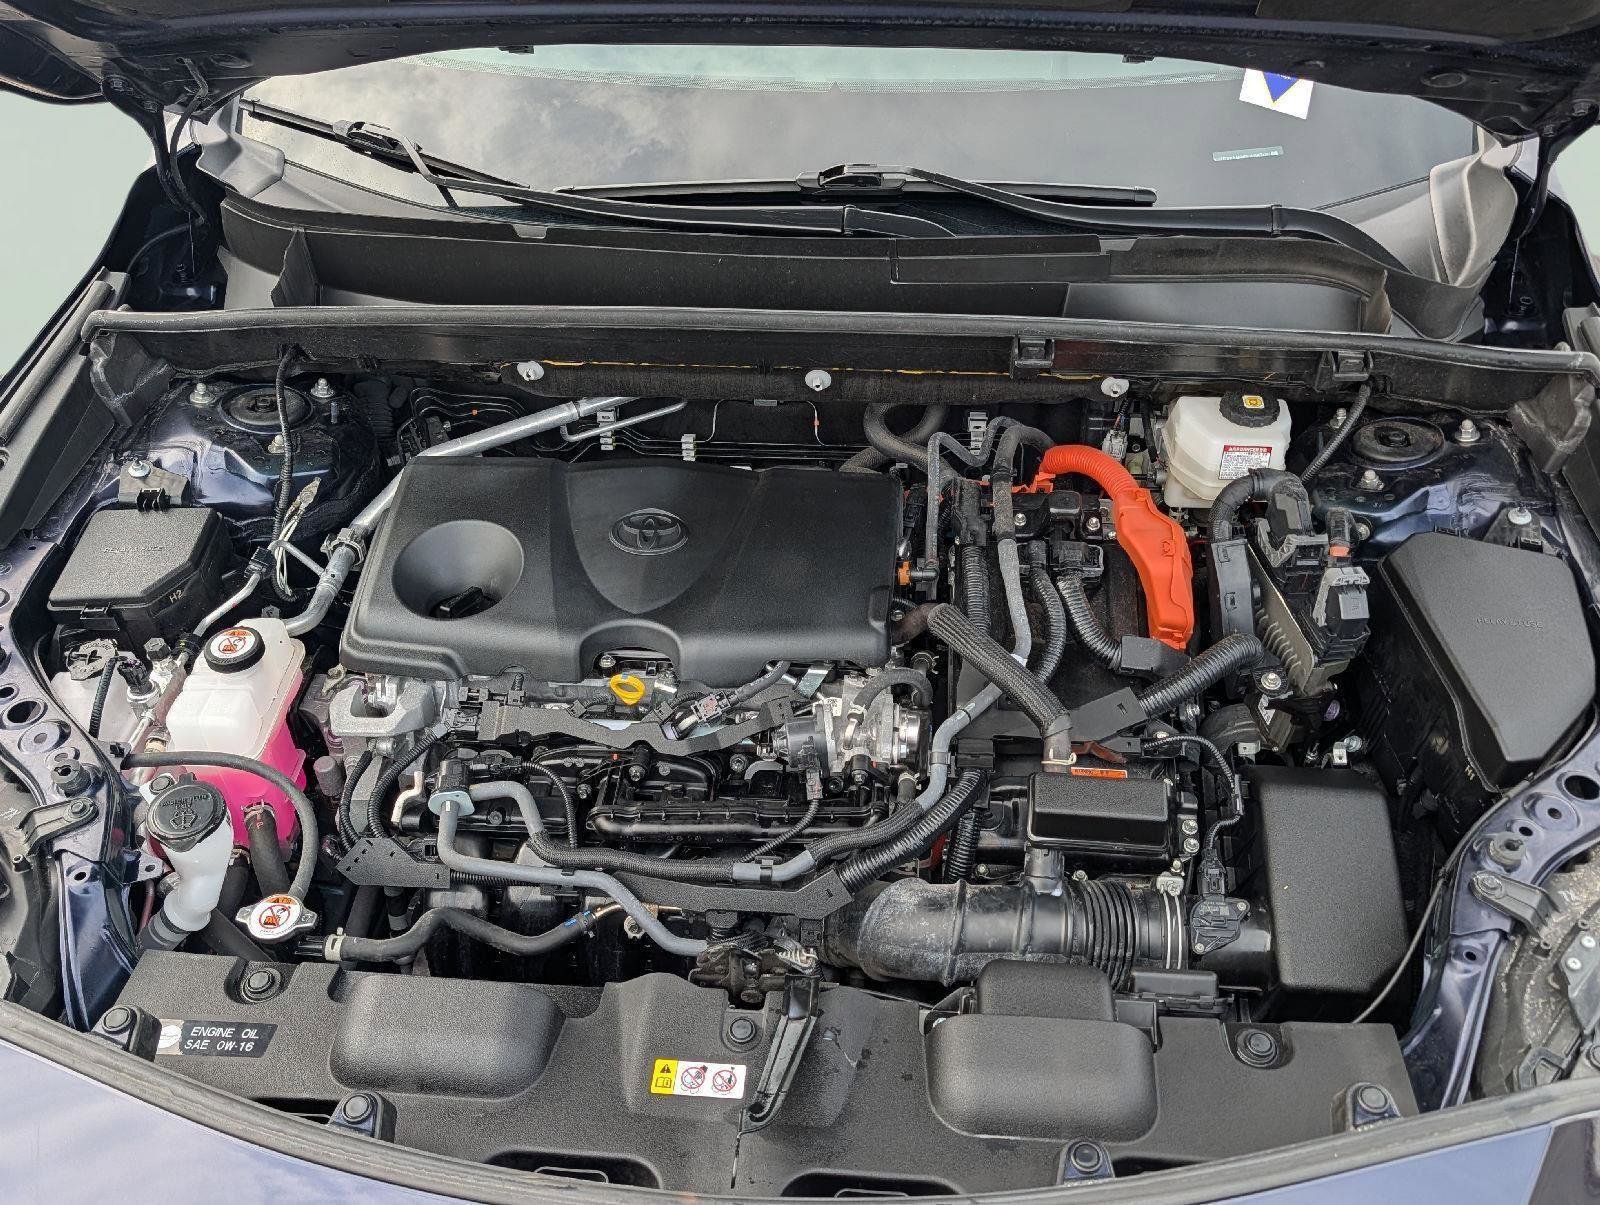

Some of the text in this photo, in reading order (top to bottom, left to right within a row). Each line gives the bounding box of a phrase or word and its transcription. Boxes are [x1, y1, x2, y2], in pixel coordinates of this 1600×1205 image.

[169, 589, 183, 604] H2
[190, 1026, 260, 1040] ENGINE OIL
[184, 1039, 255, 1052] SAE 0W-16
